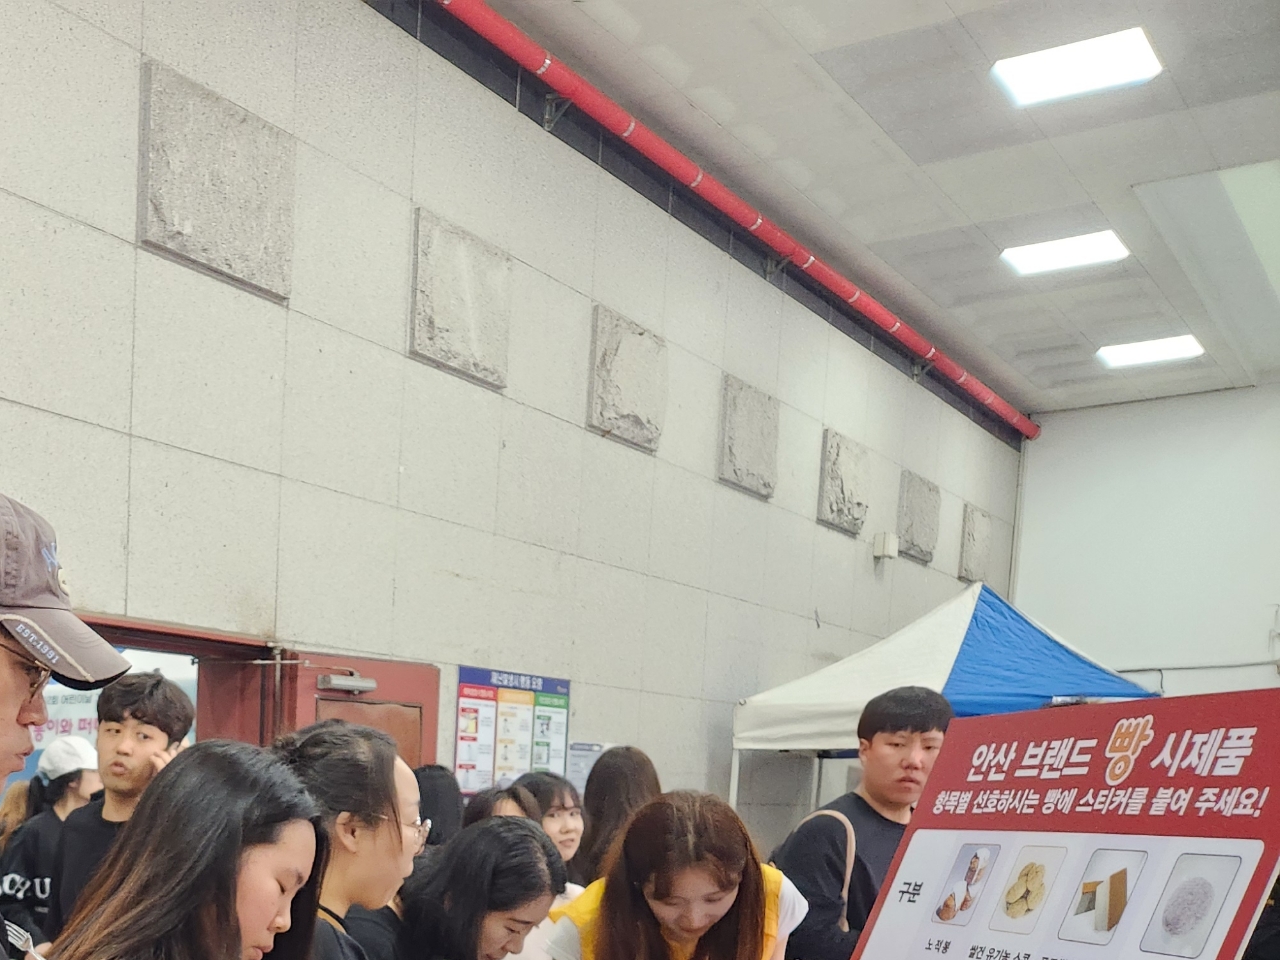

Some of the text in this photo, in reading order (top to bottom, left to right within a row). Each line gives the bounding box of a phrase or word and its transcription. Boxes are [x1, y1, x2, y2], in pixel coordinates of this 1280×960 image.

[15, 623, 59, 664] EST.1991
[966, 714, 1258, 785] 안산 브랜드 빵 시제품
[932, 786, 1270, 818] 항목별 선호하시는 빵에 스티커를 붙여 주세요!
[898, 881, 924, 905] 구분
